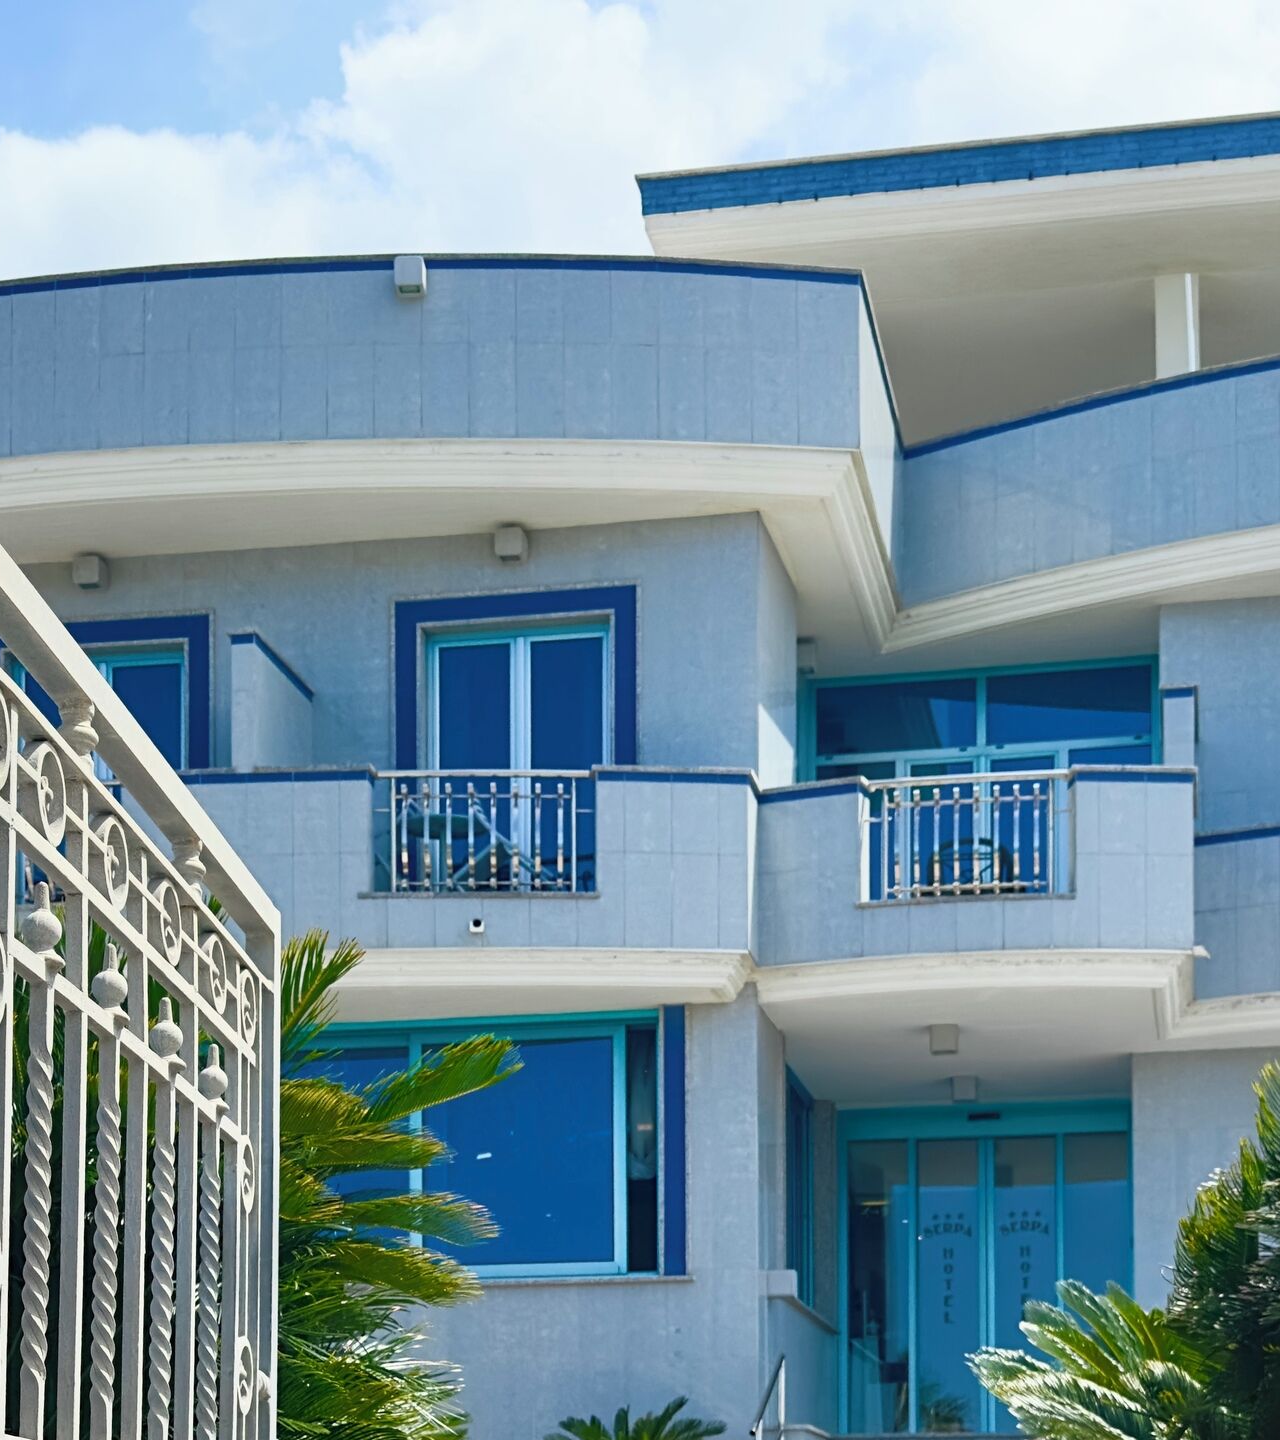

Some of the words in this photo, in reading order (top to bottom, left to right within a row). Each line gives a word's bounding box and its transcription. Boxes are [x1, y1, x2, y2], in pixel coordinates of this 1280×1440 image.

[923, 1222, 972, 1238] SERPA
[1000, 1220, 1049, 1236] SERPA
[943, 1247, 955, 1324] HOTEL
